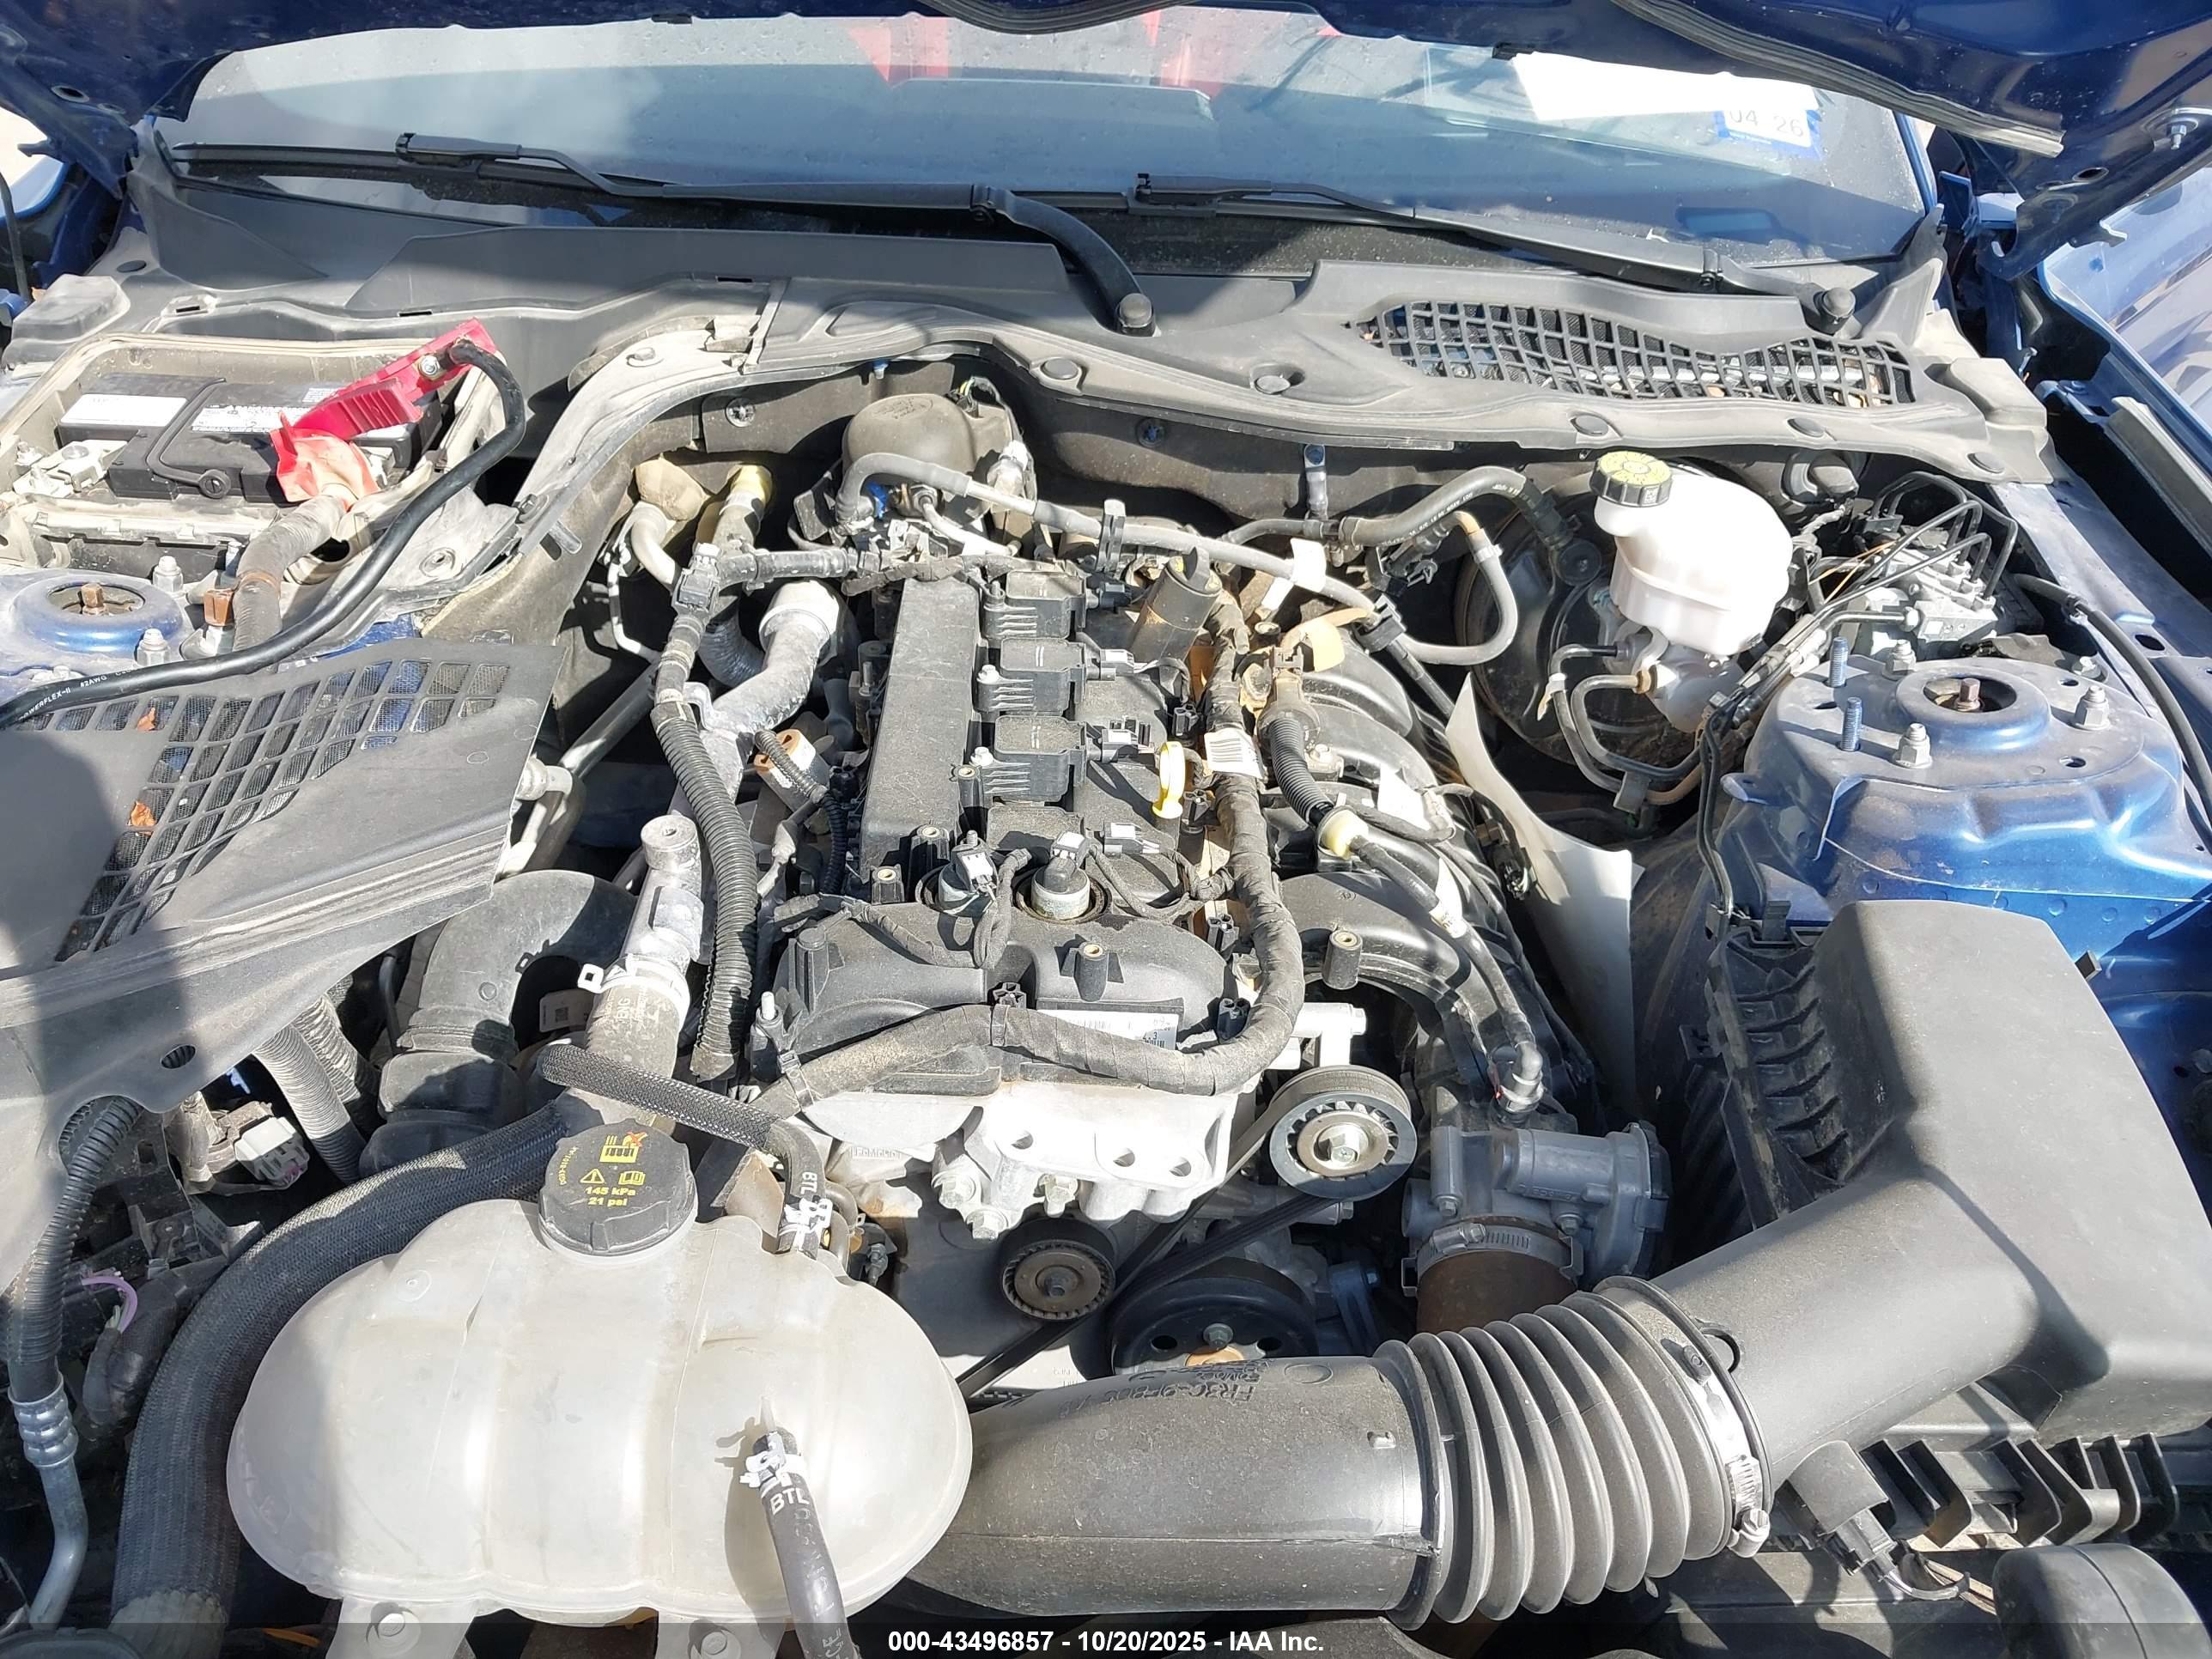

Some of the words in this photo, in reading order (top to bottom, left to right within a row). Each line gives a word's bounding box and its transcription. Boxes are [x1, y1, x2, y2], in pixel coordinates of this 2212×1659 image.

[1772, 115, 1804, 137] 26
[585, 1187, 610, 1195] 145
[611, 1187, 636, 1195] kPa
[800, 1171, 818, 1194] BTL
[587, 1197, 605, 1206] 21
[607, 1197, 628, 1207] psi
[769, 1487, 811, 1516] BTL
